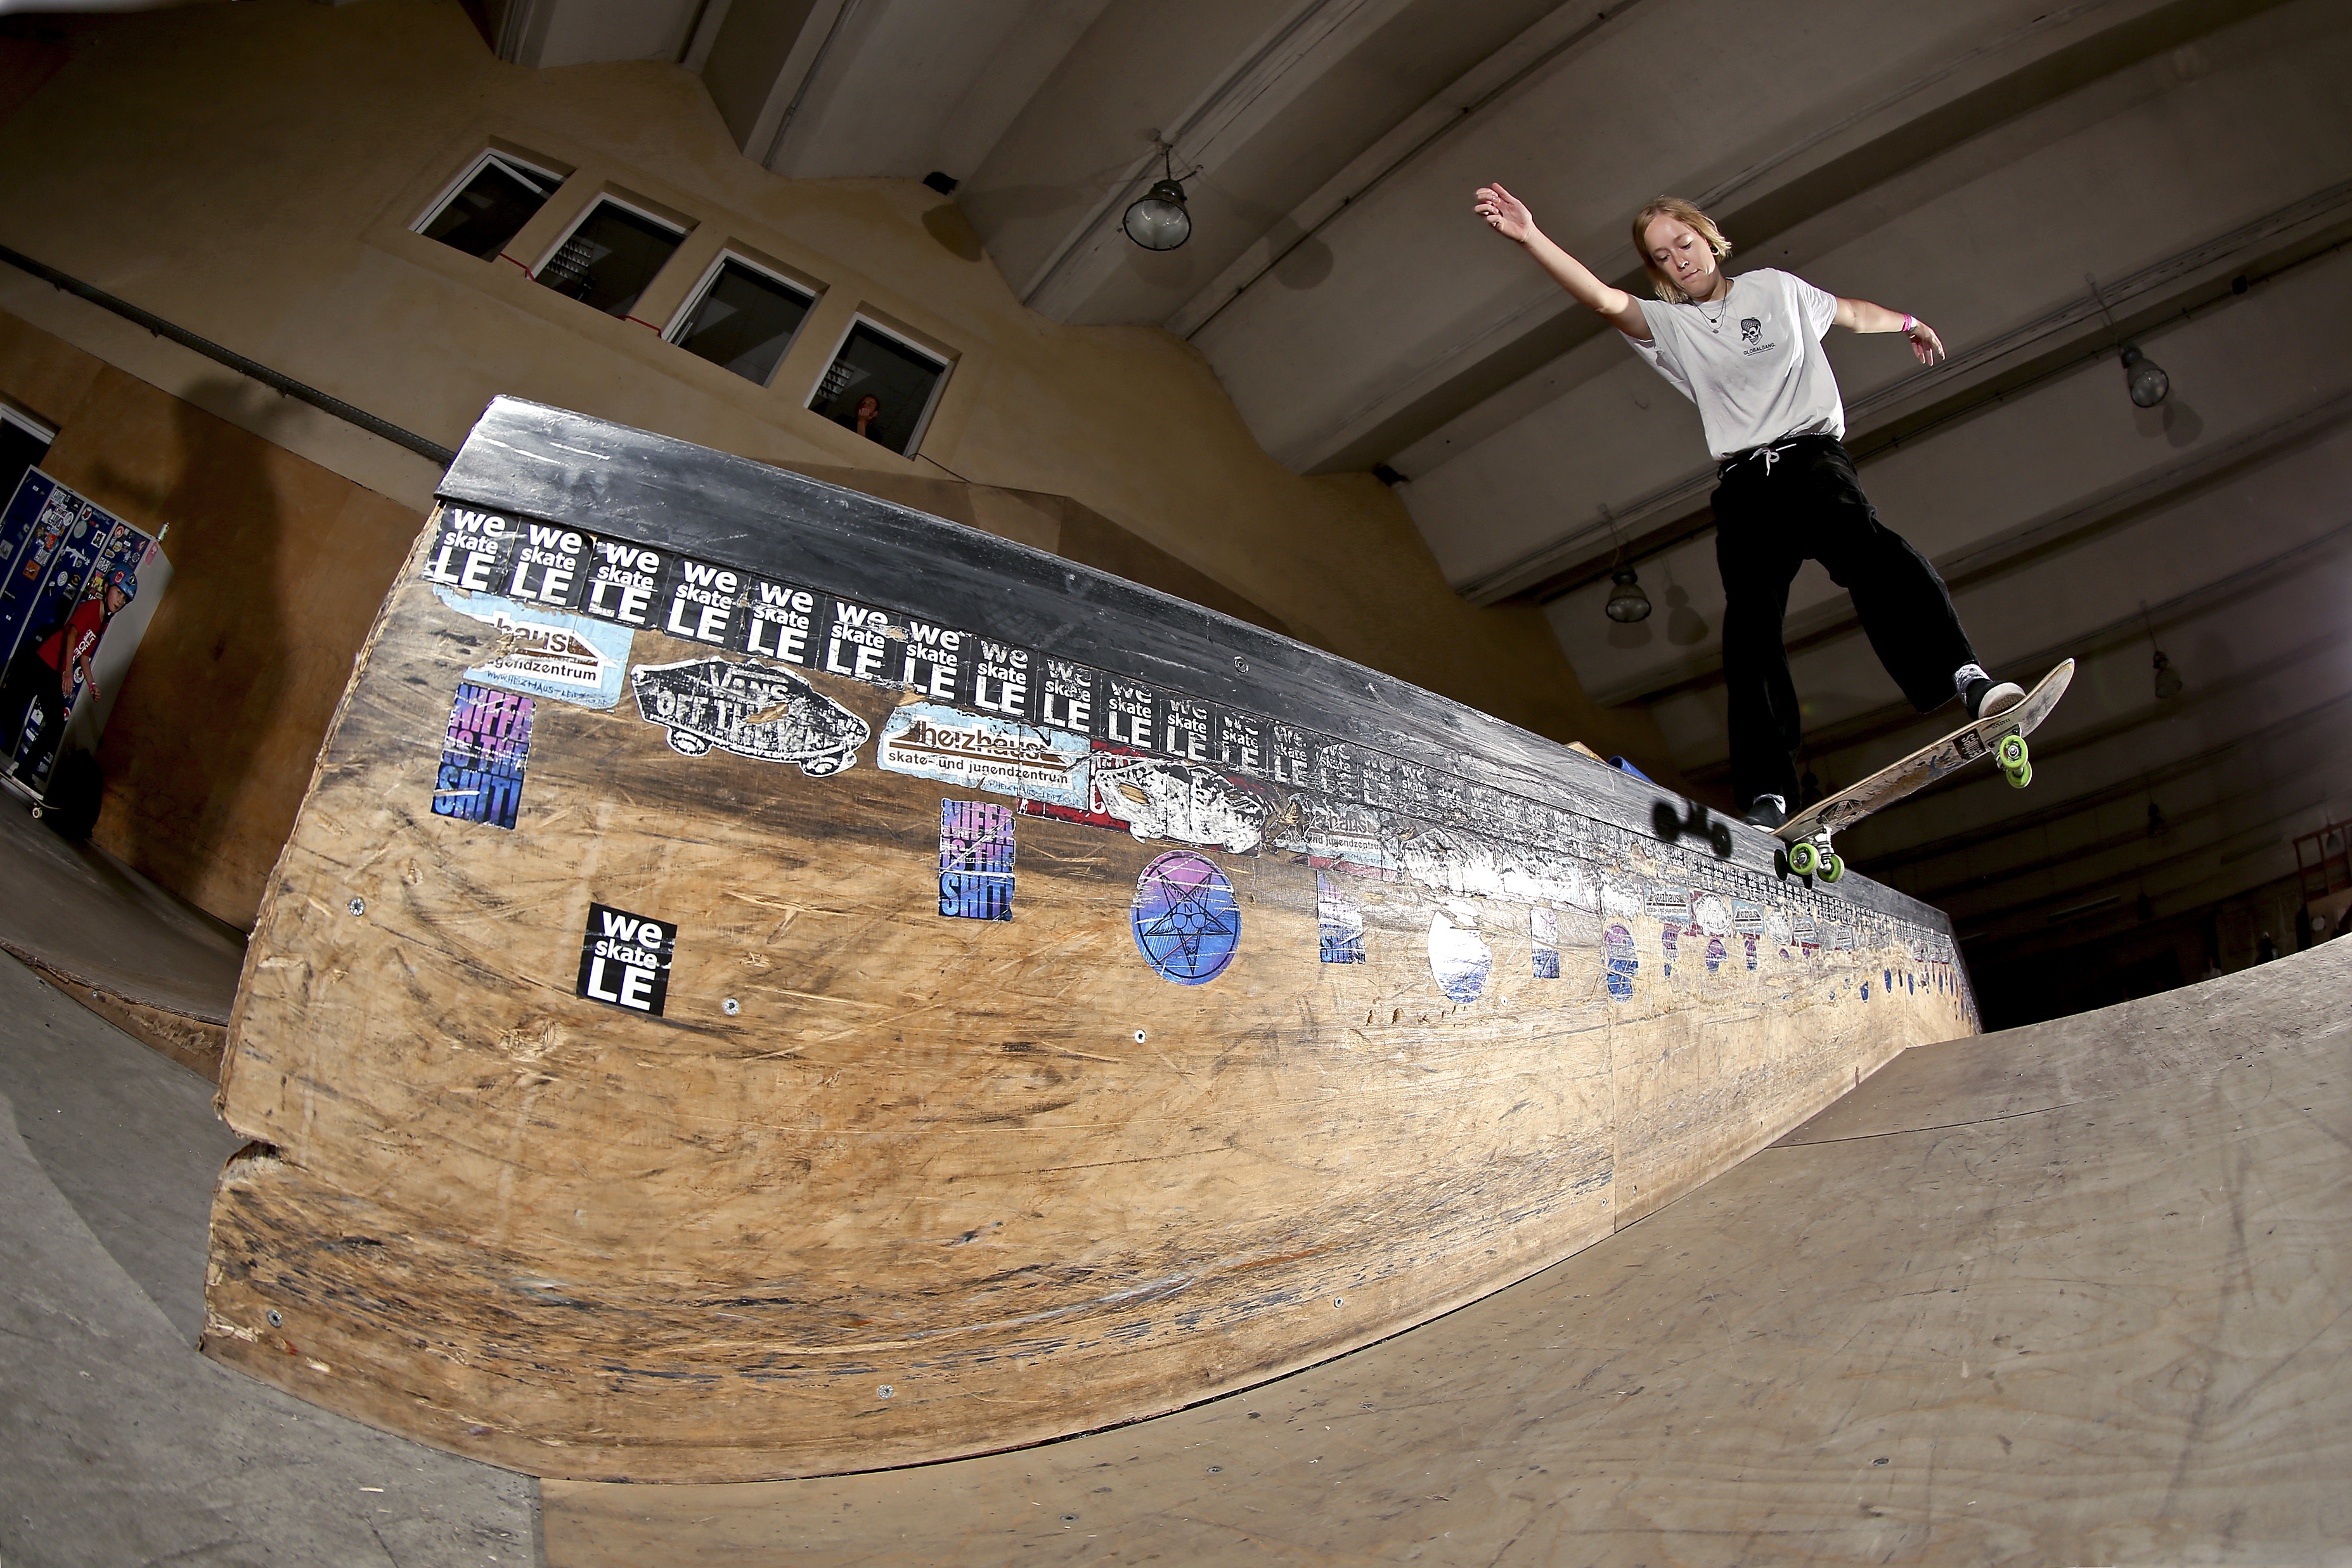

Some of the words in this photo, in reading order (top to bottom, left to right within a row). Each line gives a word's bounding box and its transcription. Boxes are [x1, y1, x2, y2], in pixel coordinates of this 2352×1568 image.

[454, 508, 505, 537] we
[444, 530, 498, 554] skate
[529, 524, 583, 554] we
[432, 546, 496, 591] LE
[520, 546, 576, 571] skate
[605, 543, 660, 574] we
[510, 562, 574, 606] LE
[597, 565, 654, 589] skate
[683, 561, 737, 593] we
[588, 579, 651, 626] LE
[675, 583, 732, 610] skate
[760, 581, 813, 613] we
[666, 598, 730, 643] LE
[754, 607, 810, 630] skate
[836, 601, 889, 626] we
[747, 619, 808, 664] LE
[830, 622, 886, 649] skate
[910, 620, 960, 651] we
[826, 638, 884, 681] LE
[906, 642, 958, 667] skate
[980, 639, 1028, 669] we
[903, 657, 957, 700] LE
[977, 662, 1026, 686] skate
[1047, 659, 1091, 687] we
[975, 675, 1025, 716] LE
[1045, 679, 1091, 702] skate
[1111, 680, 1152, 704] we
[1043, 693, 1090, 733] LE
[1108, 697, 1152, 719] skate
[1170, 698, 1207, 720] we
[1108, 710, 1152, 749] LE
[1167, 714, 1207, 734] skate
[1222, 729, 1258, 749] skate
[1224, 715, 1258, 736] we
[443, 727, 474, 768] IS
[478, 735, 528, 780] THE
[1166, 726, 1206, 762] LE
[1274, 743, 1307, 761] skate
[888, 752, 934, 765] skate-
[939, 759, 964, 769] und
[969, 762, 1068, 784] jugendzentrum
[1320, 754, 1351, 772] skate
[1363, 769, 1391, 784] skate
[434, 765, 522, 828] SHIT!
[1402, 778, 1428, 794] skate
[972, 842, 1014, 873] THE
[602, 911, 662, 949] we
[595, 938, 657, 969] skate
[587, 956, 656, 1011] LE
